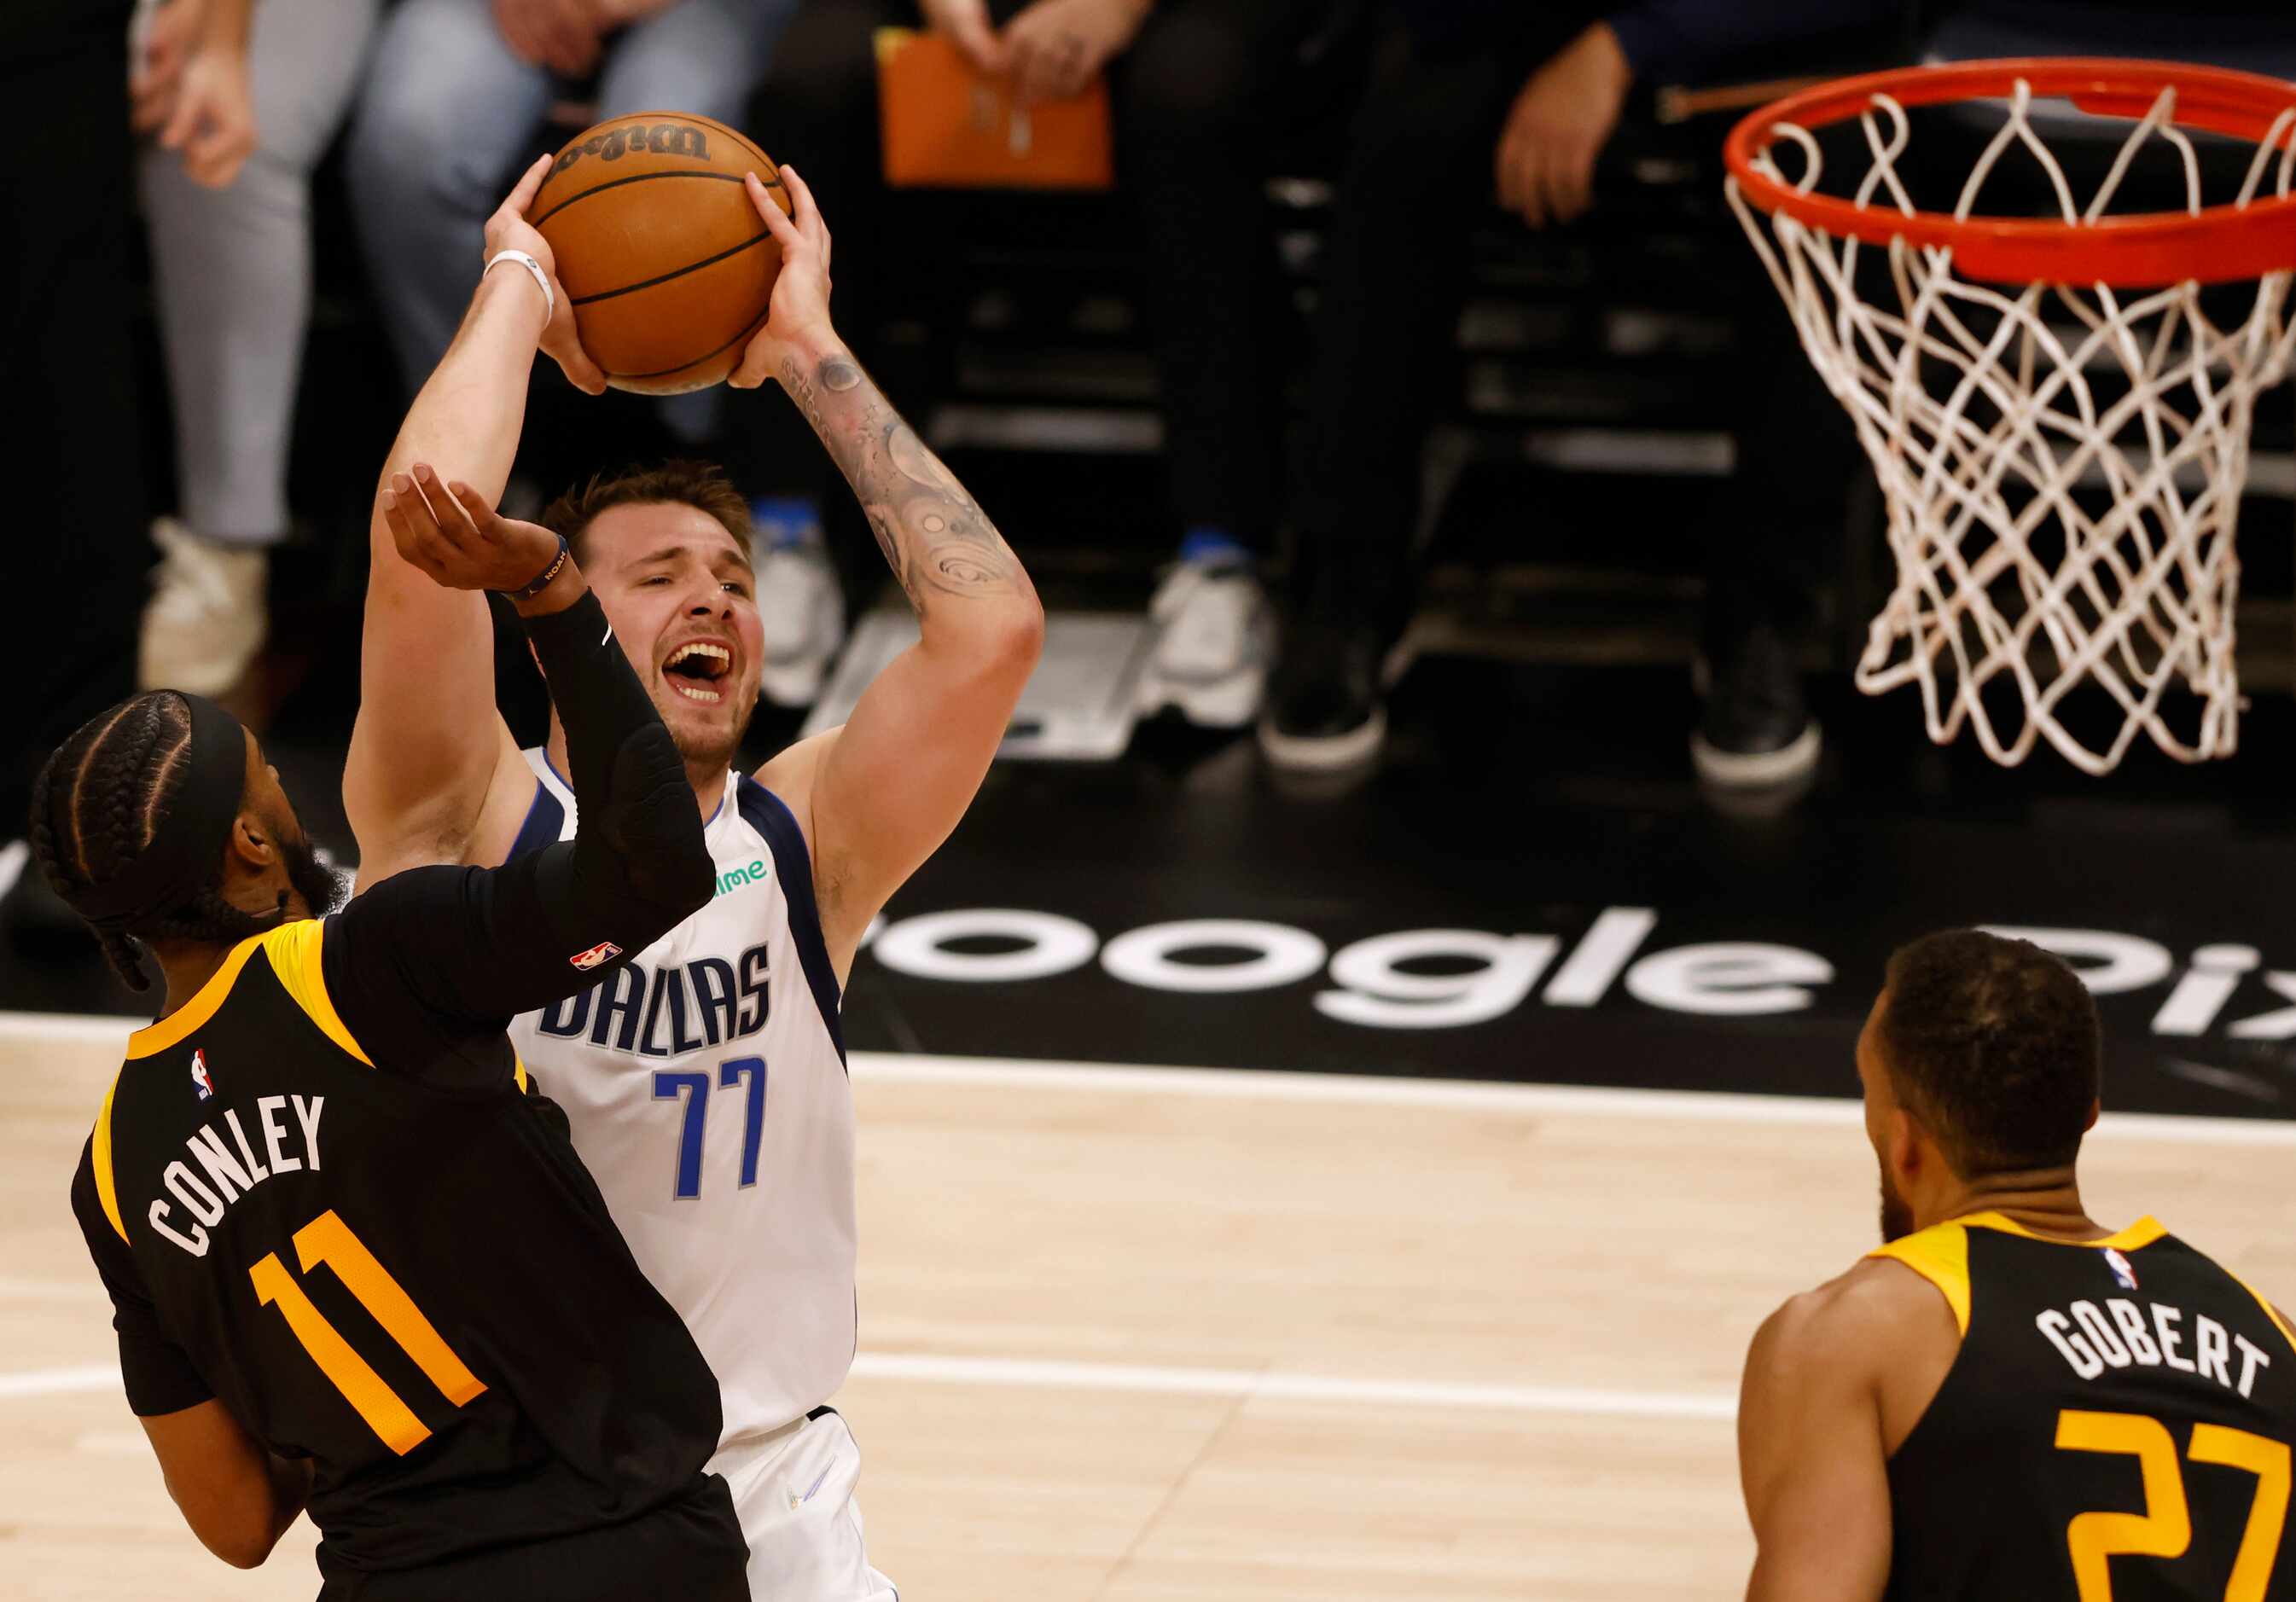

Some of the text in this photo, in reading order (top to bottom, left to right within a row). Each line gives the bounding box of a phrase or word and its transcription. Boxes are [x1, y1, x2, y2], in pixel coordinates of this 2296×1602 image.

[544, 550, 567, 581] NOAH
[714, 860, 767, 898] ime
[535, 940, 771, 1059] DALLAS
[860, 906, 1833, 1028] oogle
[148, 1094, 324, 1257] CONLEY
[651, 1054, 768, 1201] 77
[248, 1209, 488, 1457] 11
[2036, 1297, 2270, 1399] GOBERT
[2055, 1409, 2291, 1602] 27
